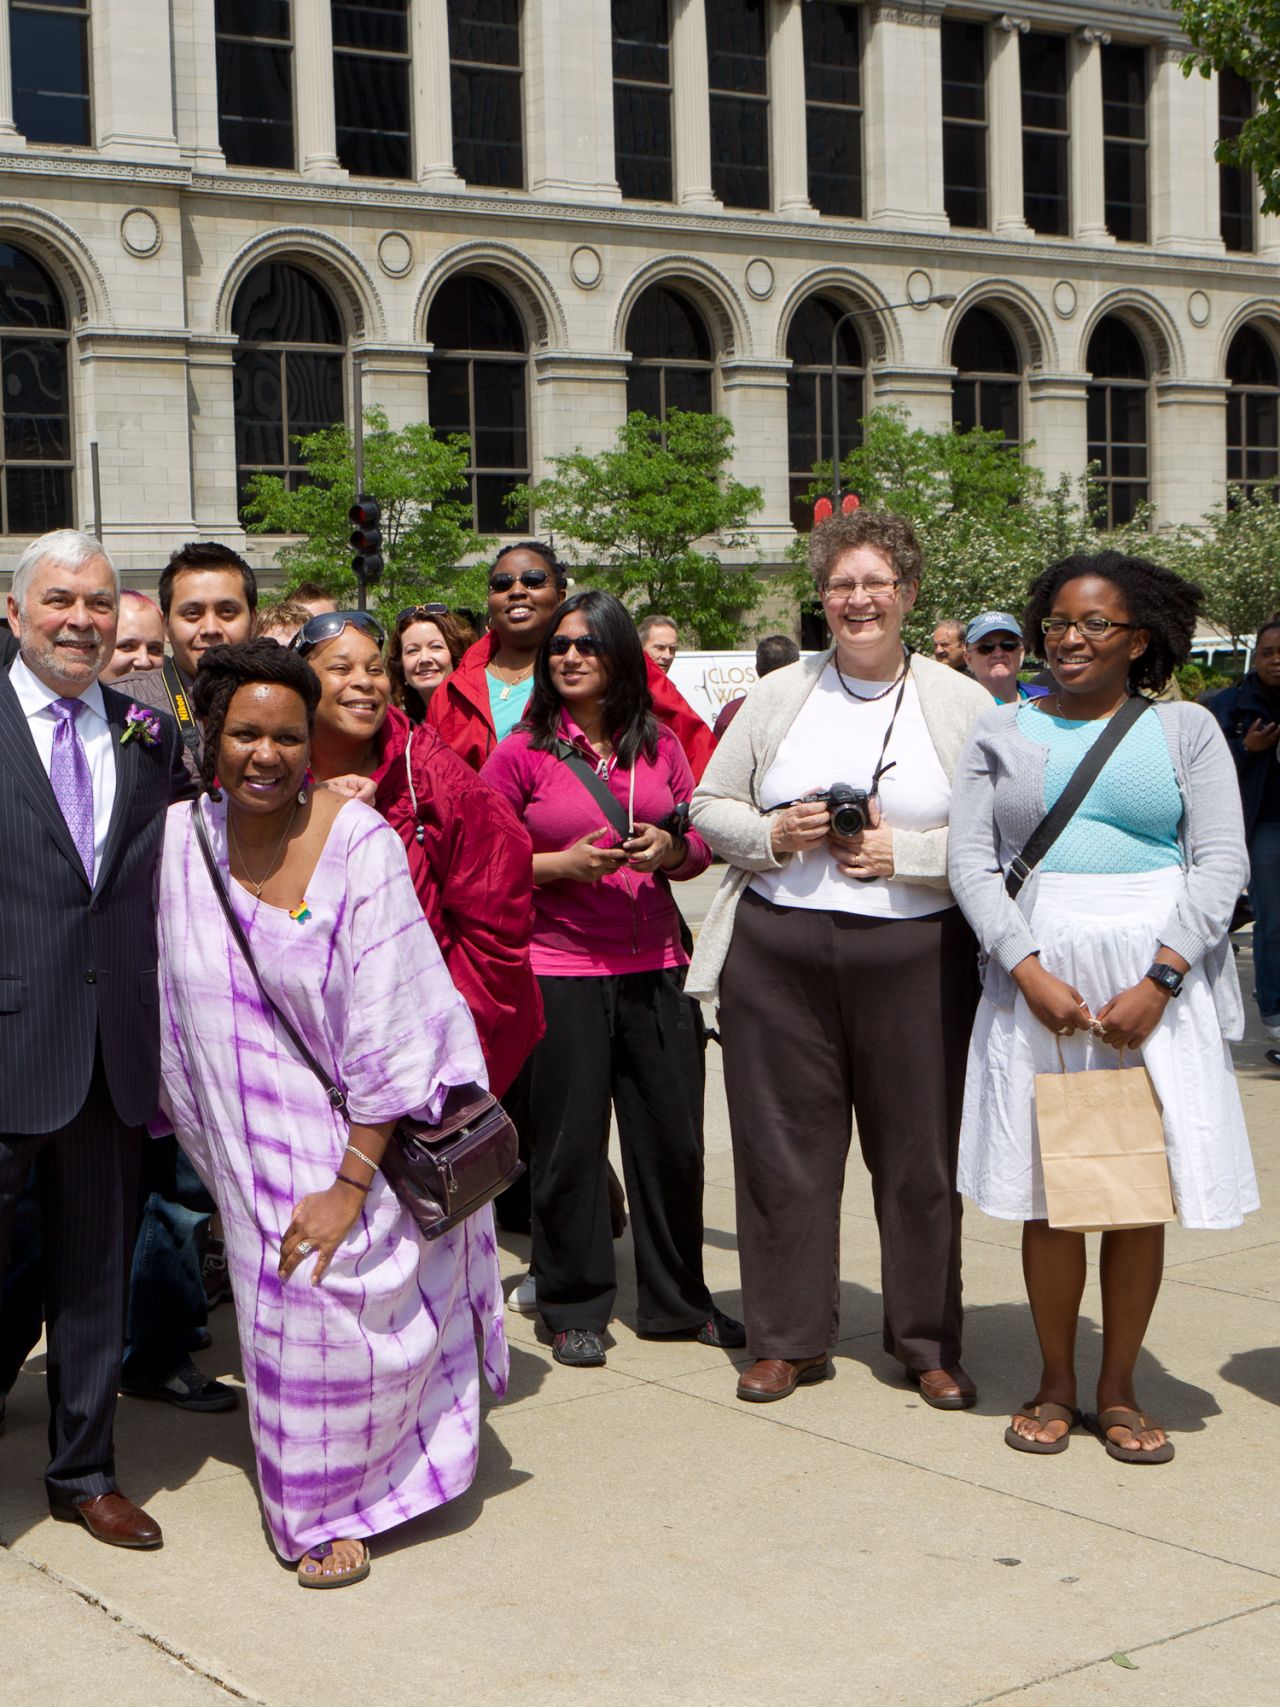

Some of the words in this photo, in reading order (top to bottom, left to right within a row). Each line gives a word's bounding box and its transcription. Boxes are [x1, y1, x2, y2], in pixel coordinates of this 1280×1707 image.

[708, 667, 756, 684] CLOS
[713, 687, 748, 704] WO
[175, 694, 190, 721] Nikon
